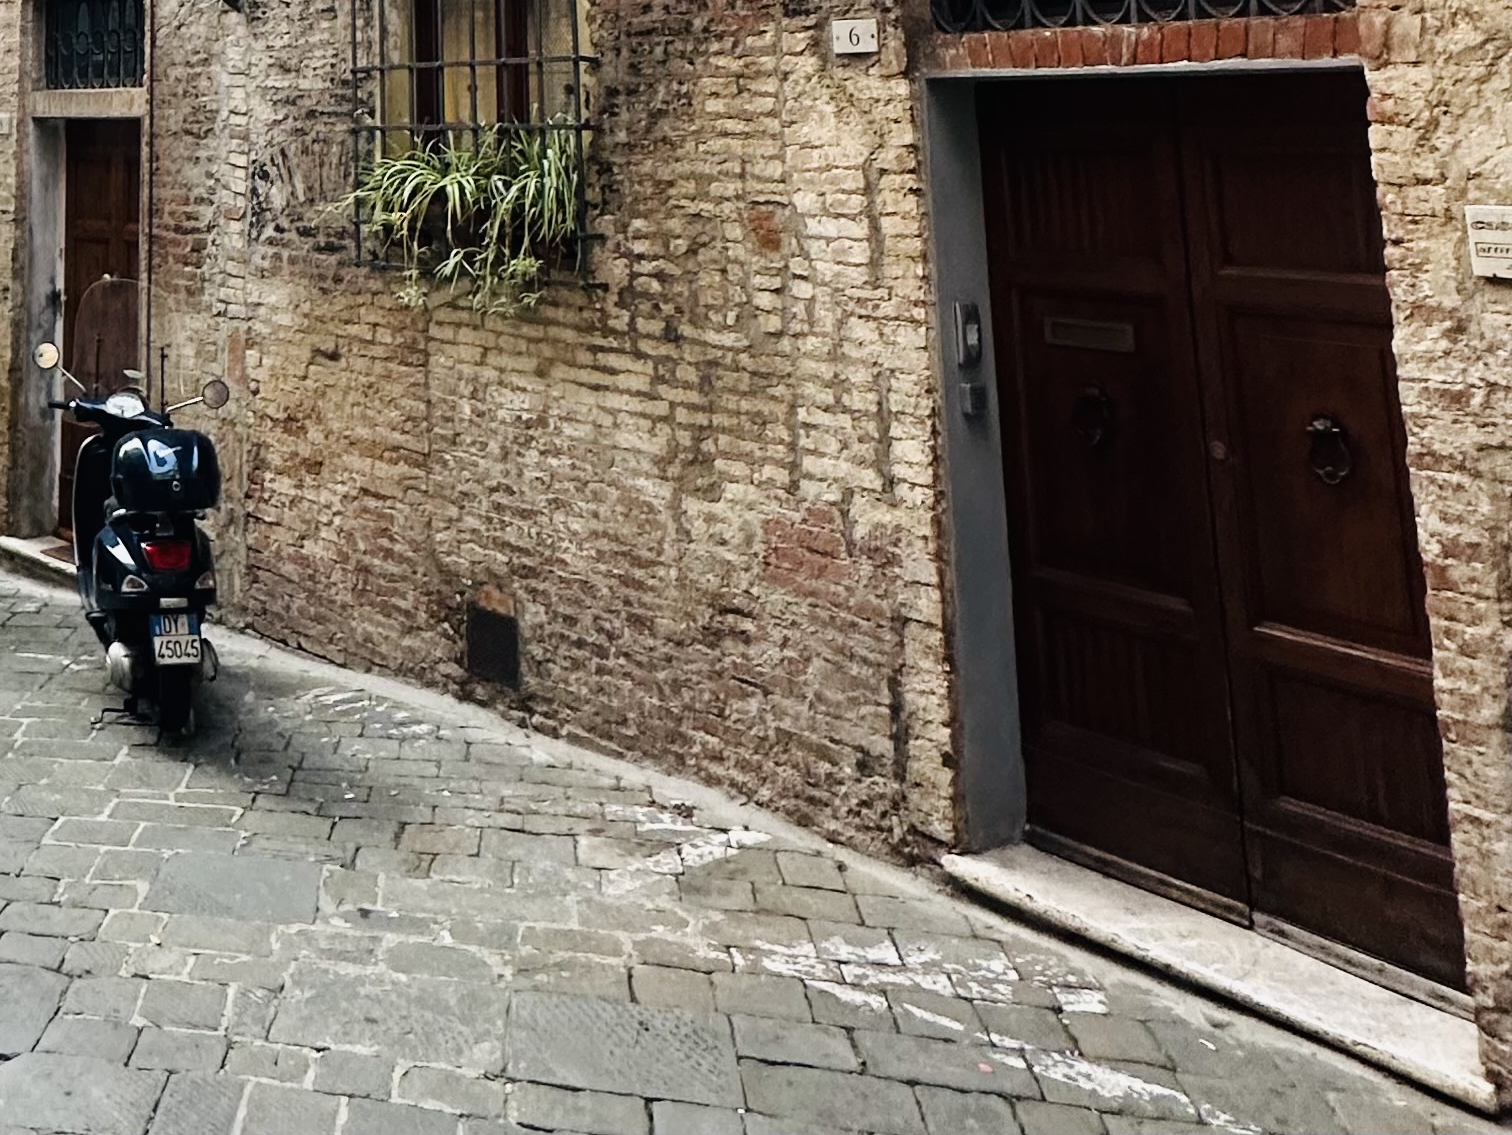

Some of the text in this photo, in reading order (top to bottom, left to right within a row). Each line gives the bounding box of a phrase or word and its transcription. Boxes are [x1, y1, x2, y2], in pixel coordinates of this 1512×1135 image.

[849, 26, 860, 46] 6
[163, 614, 179, 634] DY
[158, 639, 199, 659] 45045
